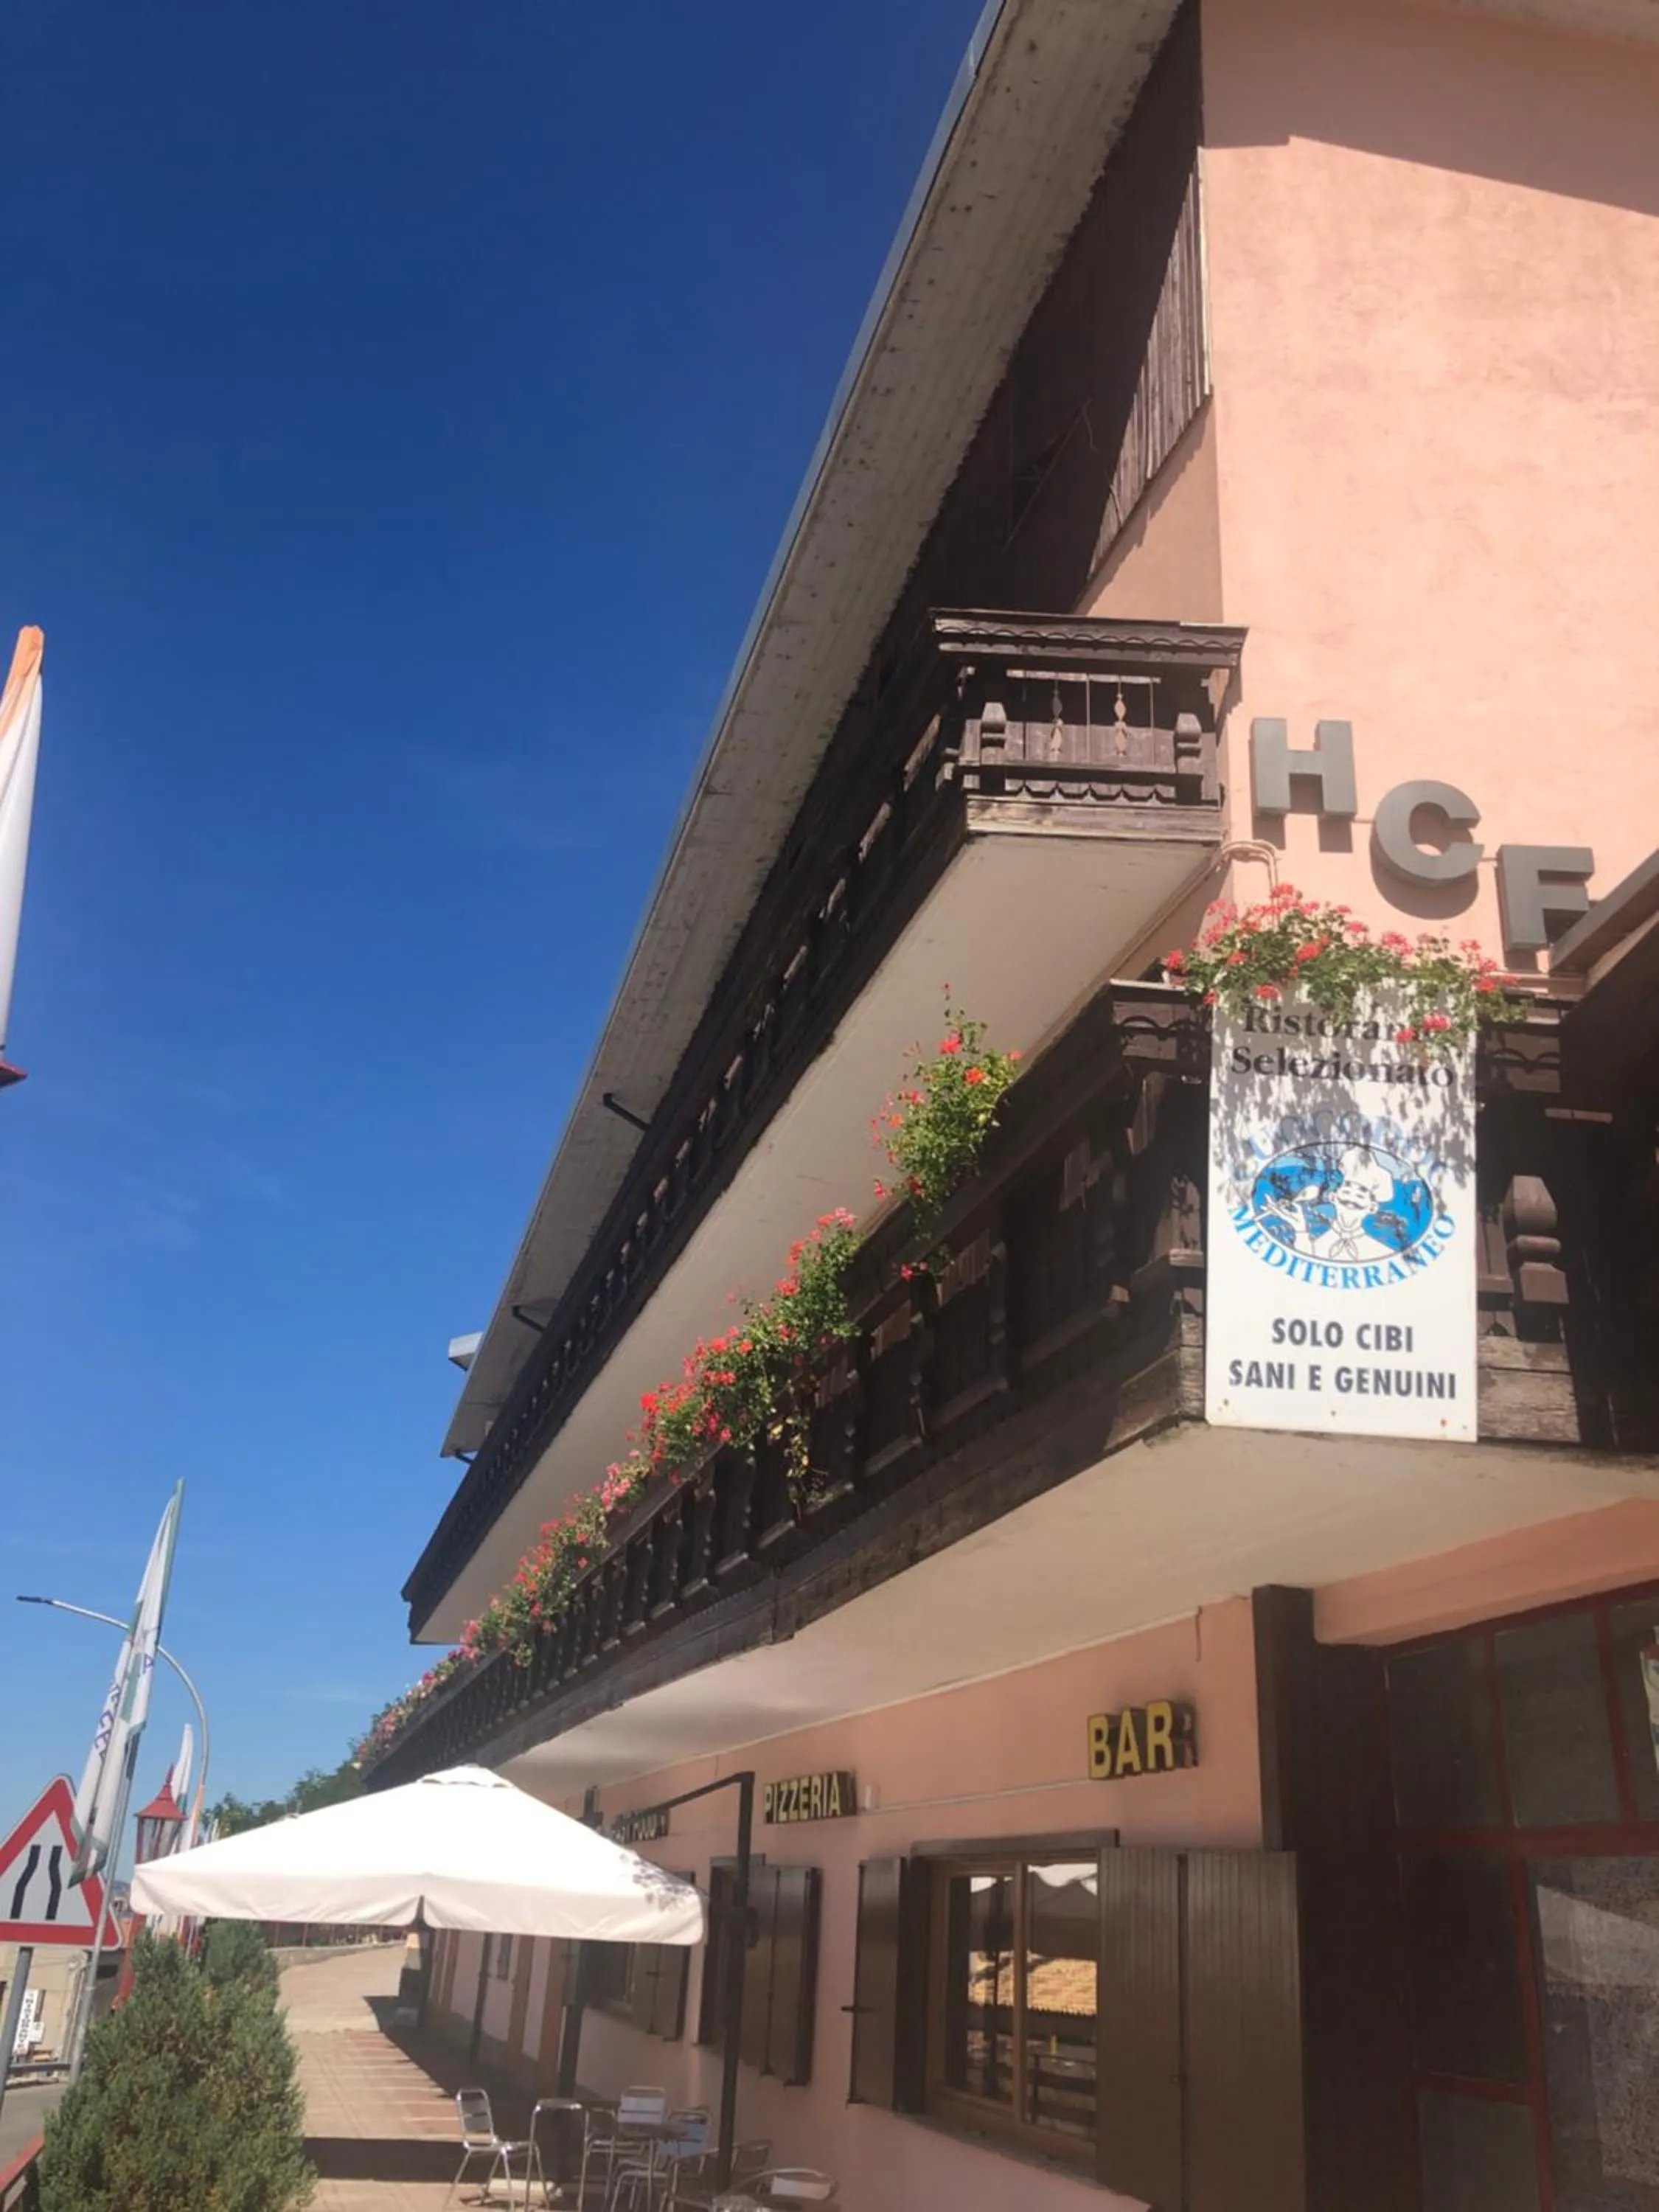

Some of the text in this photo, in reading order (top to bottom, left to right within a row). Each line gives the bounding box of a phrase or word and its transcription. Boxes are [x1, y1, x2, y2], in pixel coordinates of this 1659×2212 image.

[1242, 1005, 1438, 1041] Ristoran
[1231, 1046, 1454, 1088] Selezionato
[1228, 1202, 1457, 1290] MEDITERRANEO
[1271, 1318, 1414, 1352] SOLO CIBI
[1228, 1359, 1457, 1399] SANI E GENUINI
[1087, 1699, 1175, 1779] BAR
[764, 1772, 841, 1824] PIZZERIA
